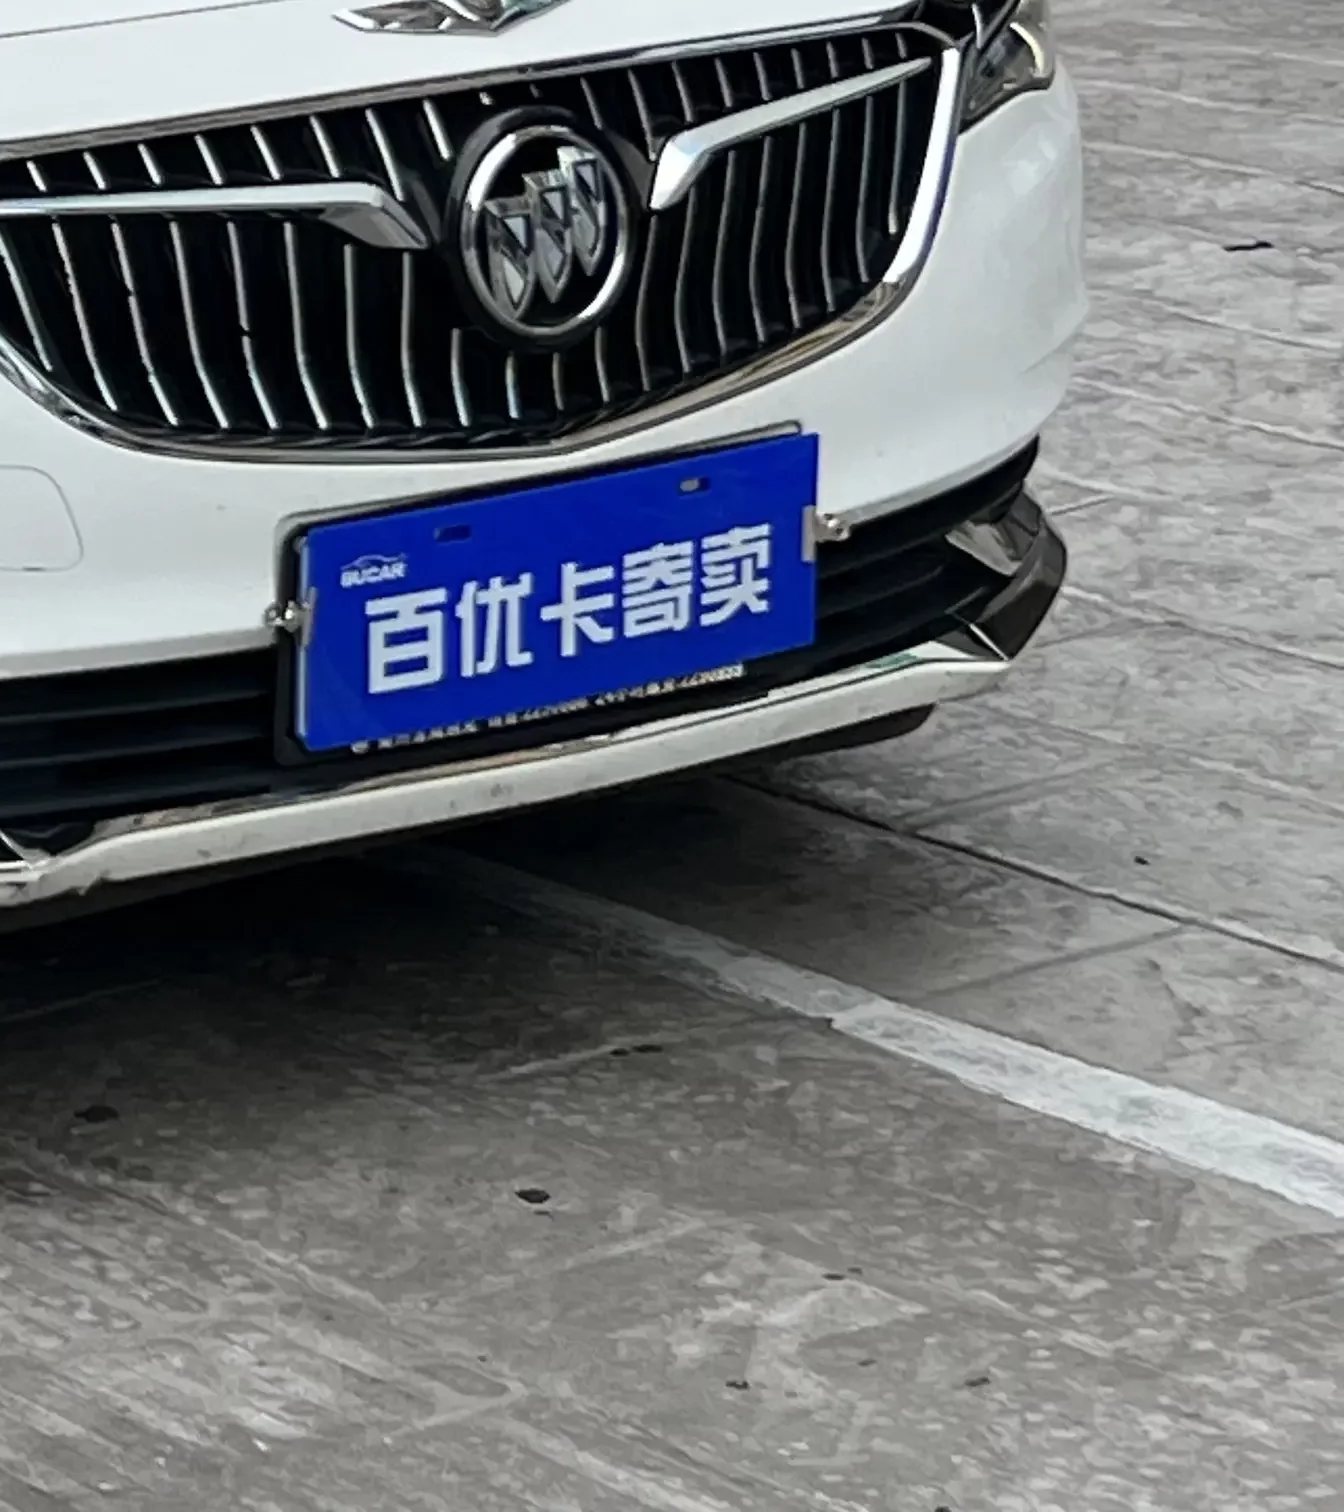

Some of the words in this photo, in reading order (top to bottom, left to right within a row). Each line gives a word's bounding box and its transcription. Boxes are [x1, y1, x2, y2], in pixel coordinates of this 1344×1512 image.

[365, 522, 773, 695] 百优卡寄卖
